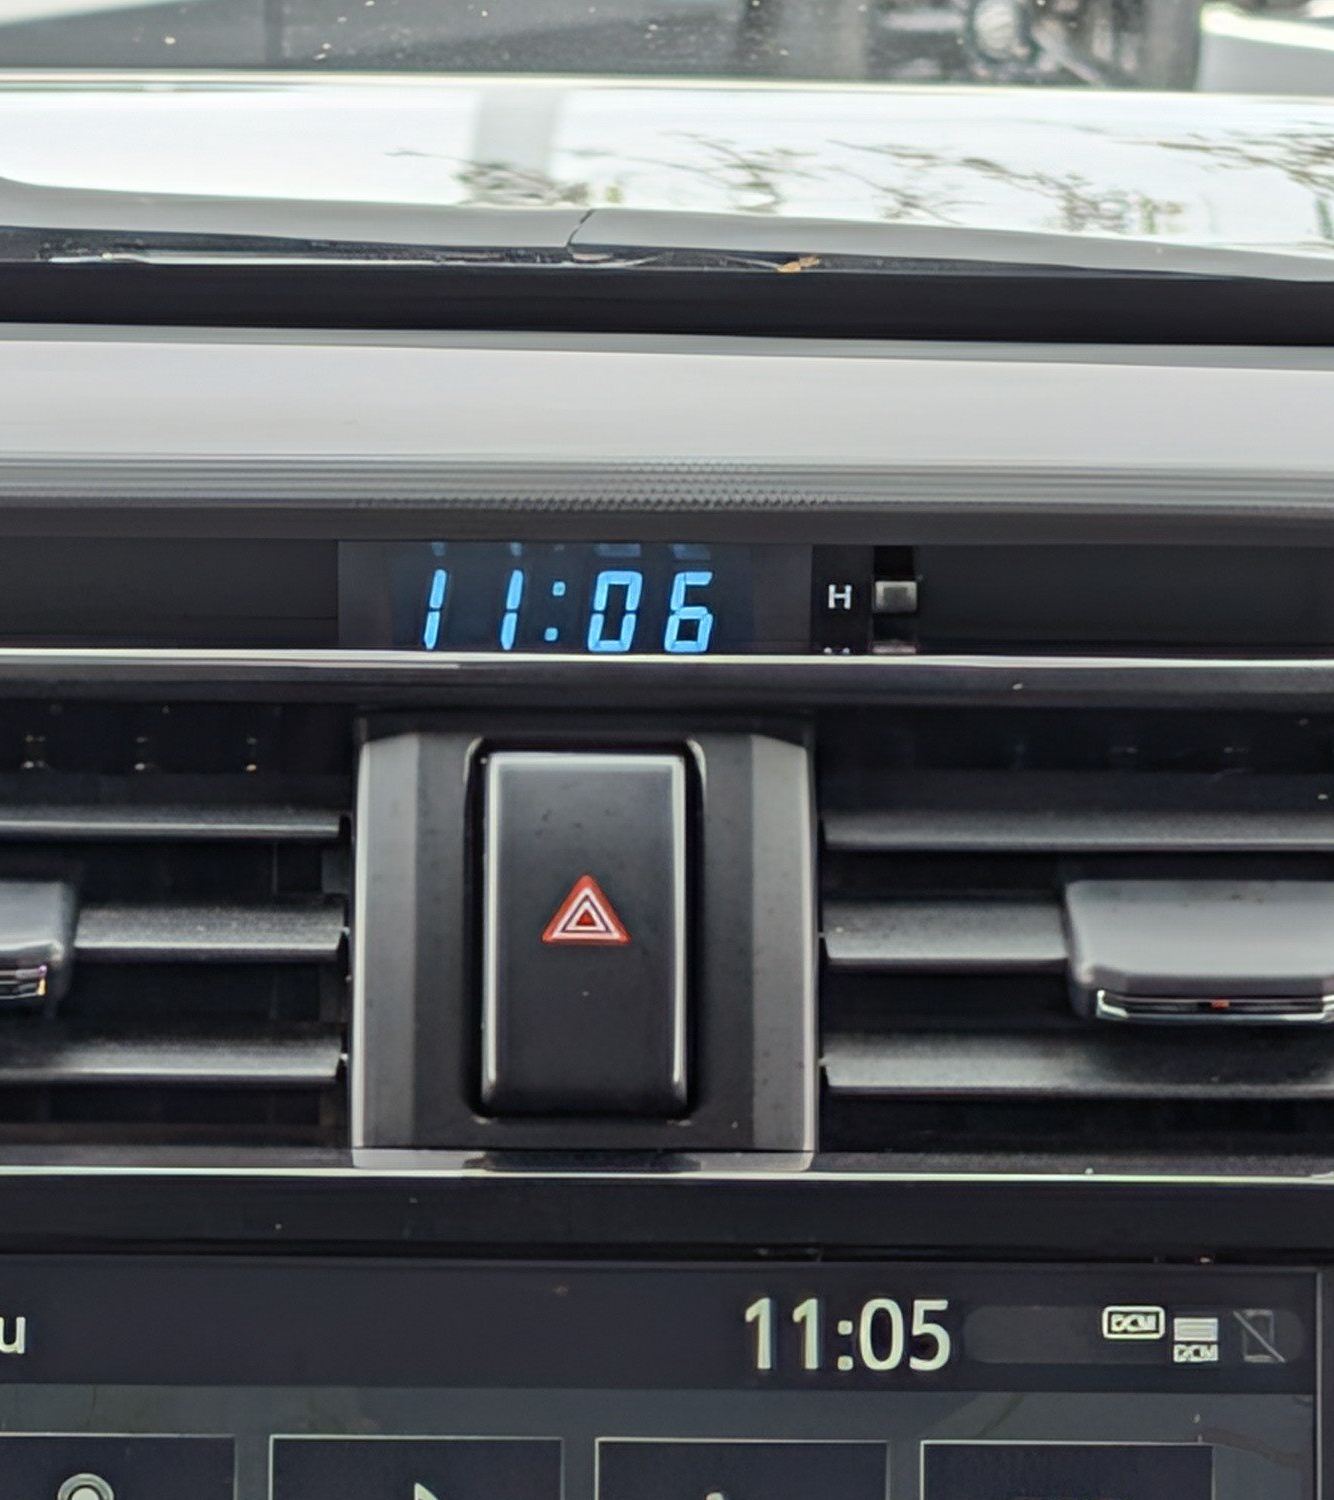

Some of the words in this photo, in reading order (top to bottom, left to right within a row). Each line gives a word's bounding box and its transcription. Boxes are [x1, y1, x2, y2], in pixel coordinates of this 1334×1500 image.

[423, 568, 713, 652] 11:06
[828, 584, 852, 610] H
[745, 1297, 951, 1371] 11:05
